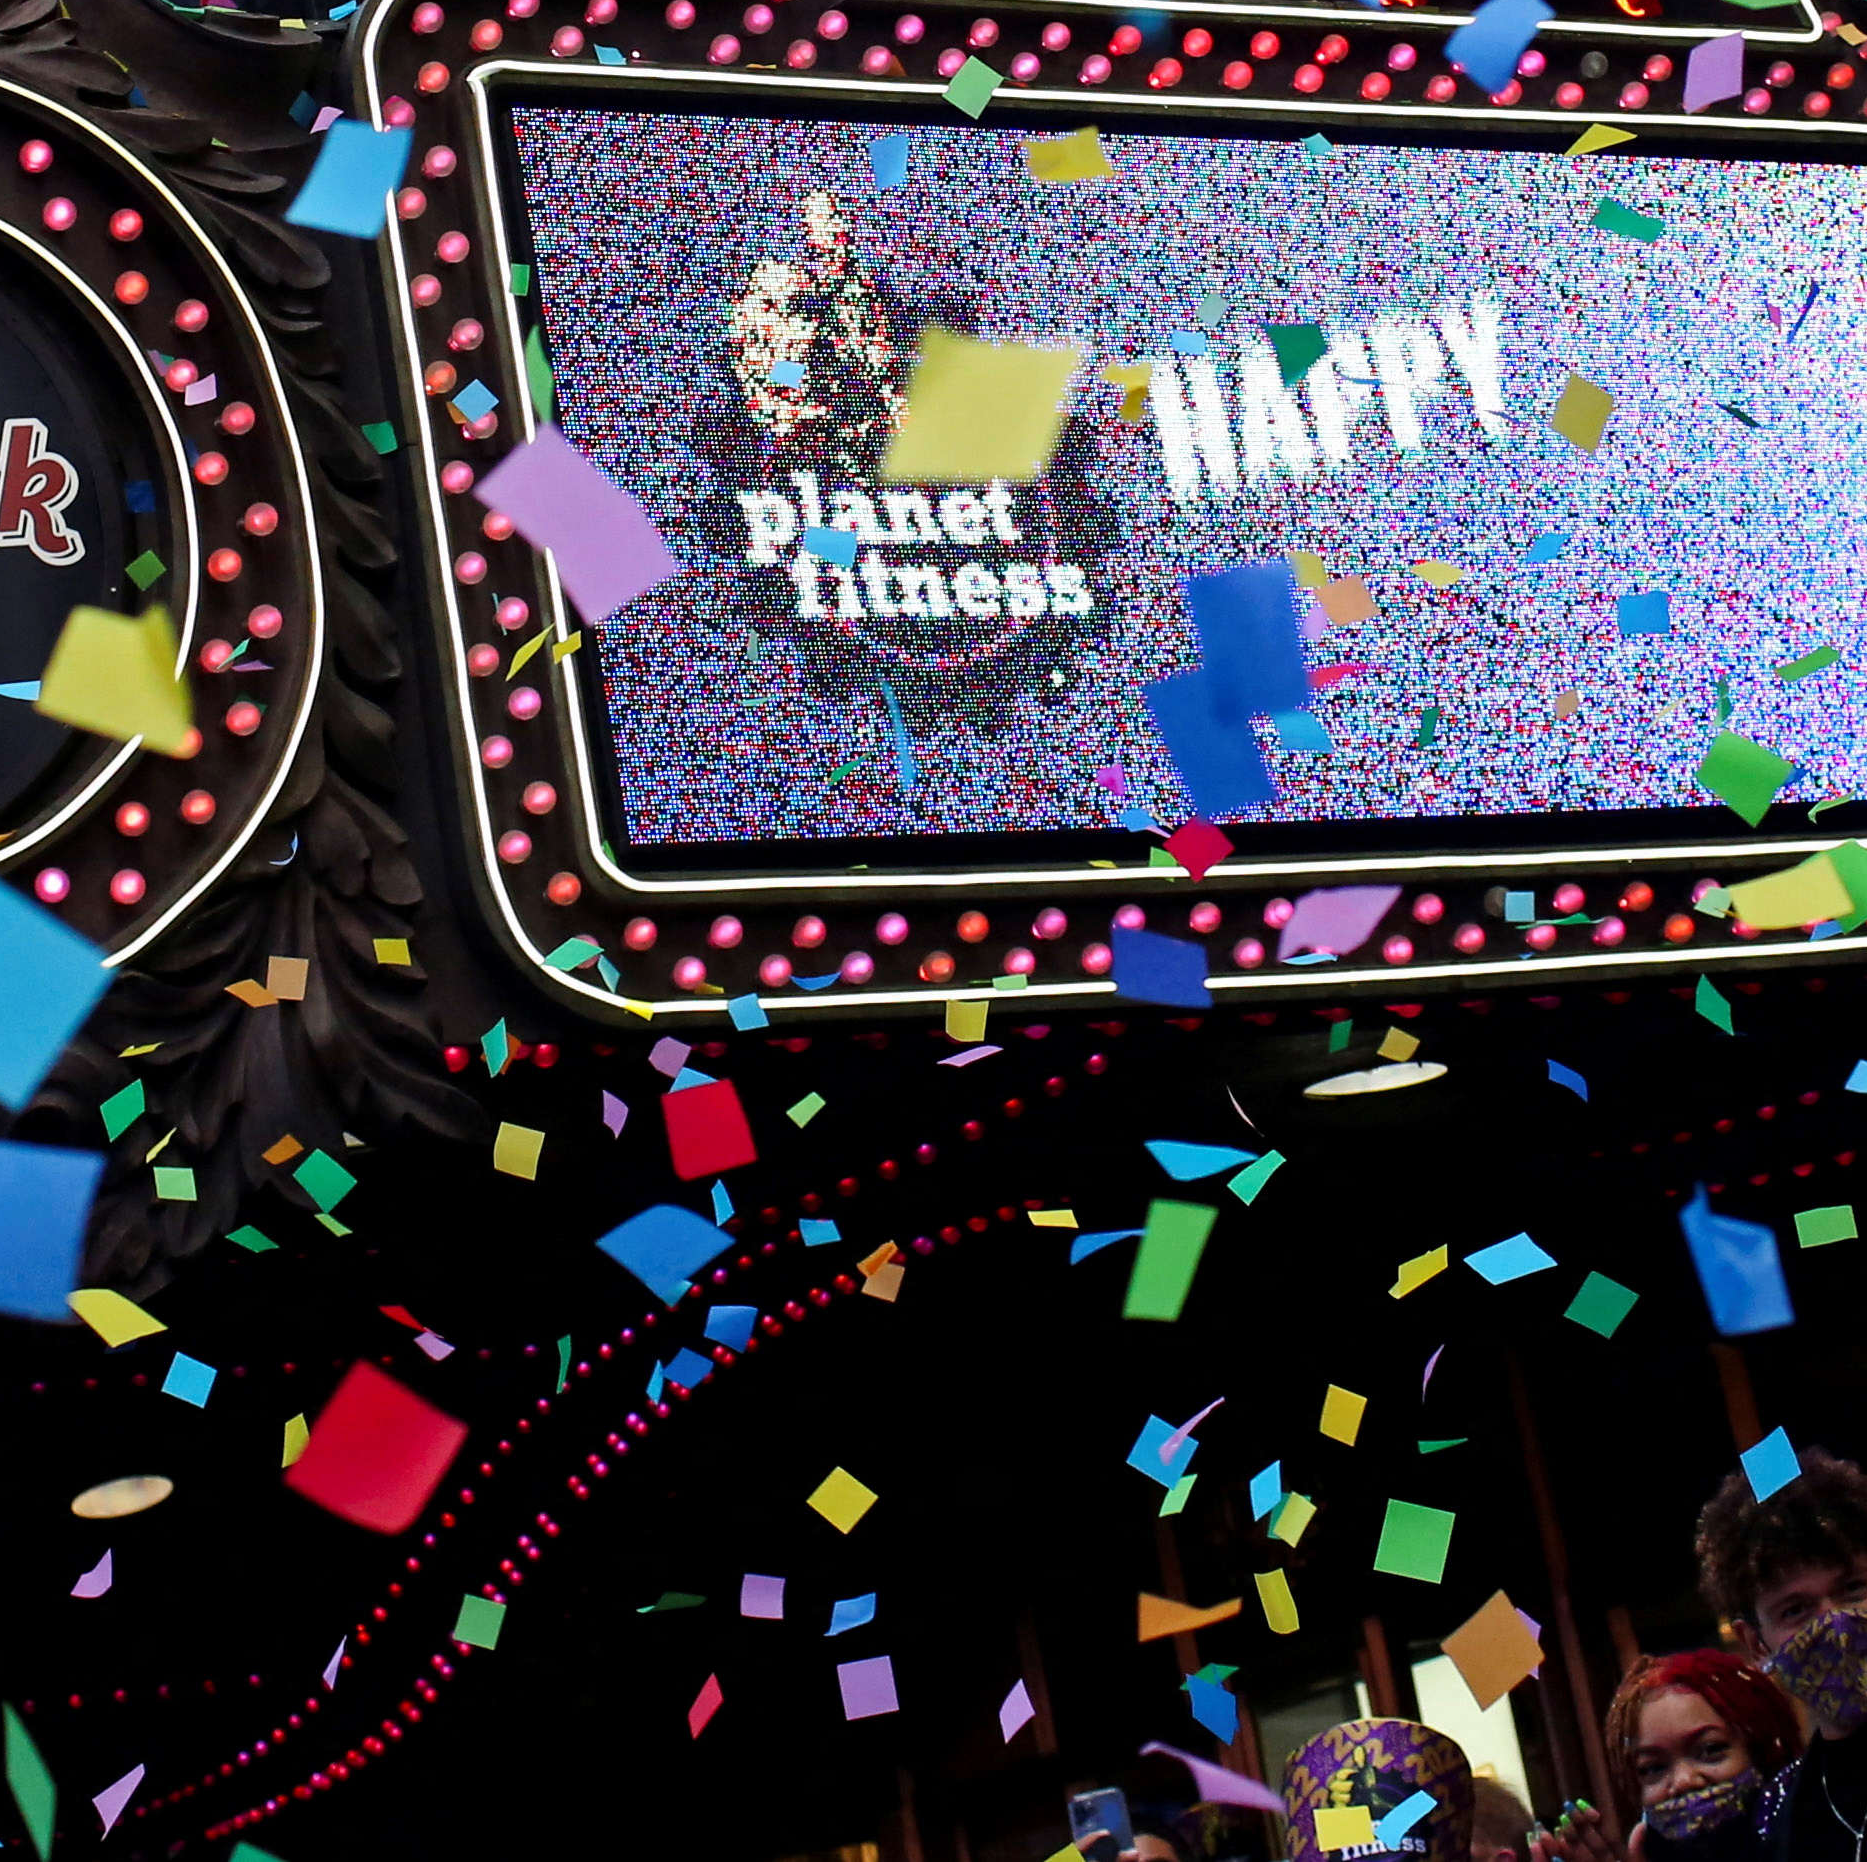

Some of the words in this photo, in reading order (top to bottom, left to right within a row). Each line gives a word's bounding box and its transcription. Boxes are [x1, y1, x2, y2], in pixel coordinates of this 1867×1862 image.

[1150, 290, 1507, 504] HAPPY
[736, 468, 1024, 566] planet
[790, 549, 1096, 621] fitness
